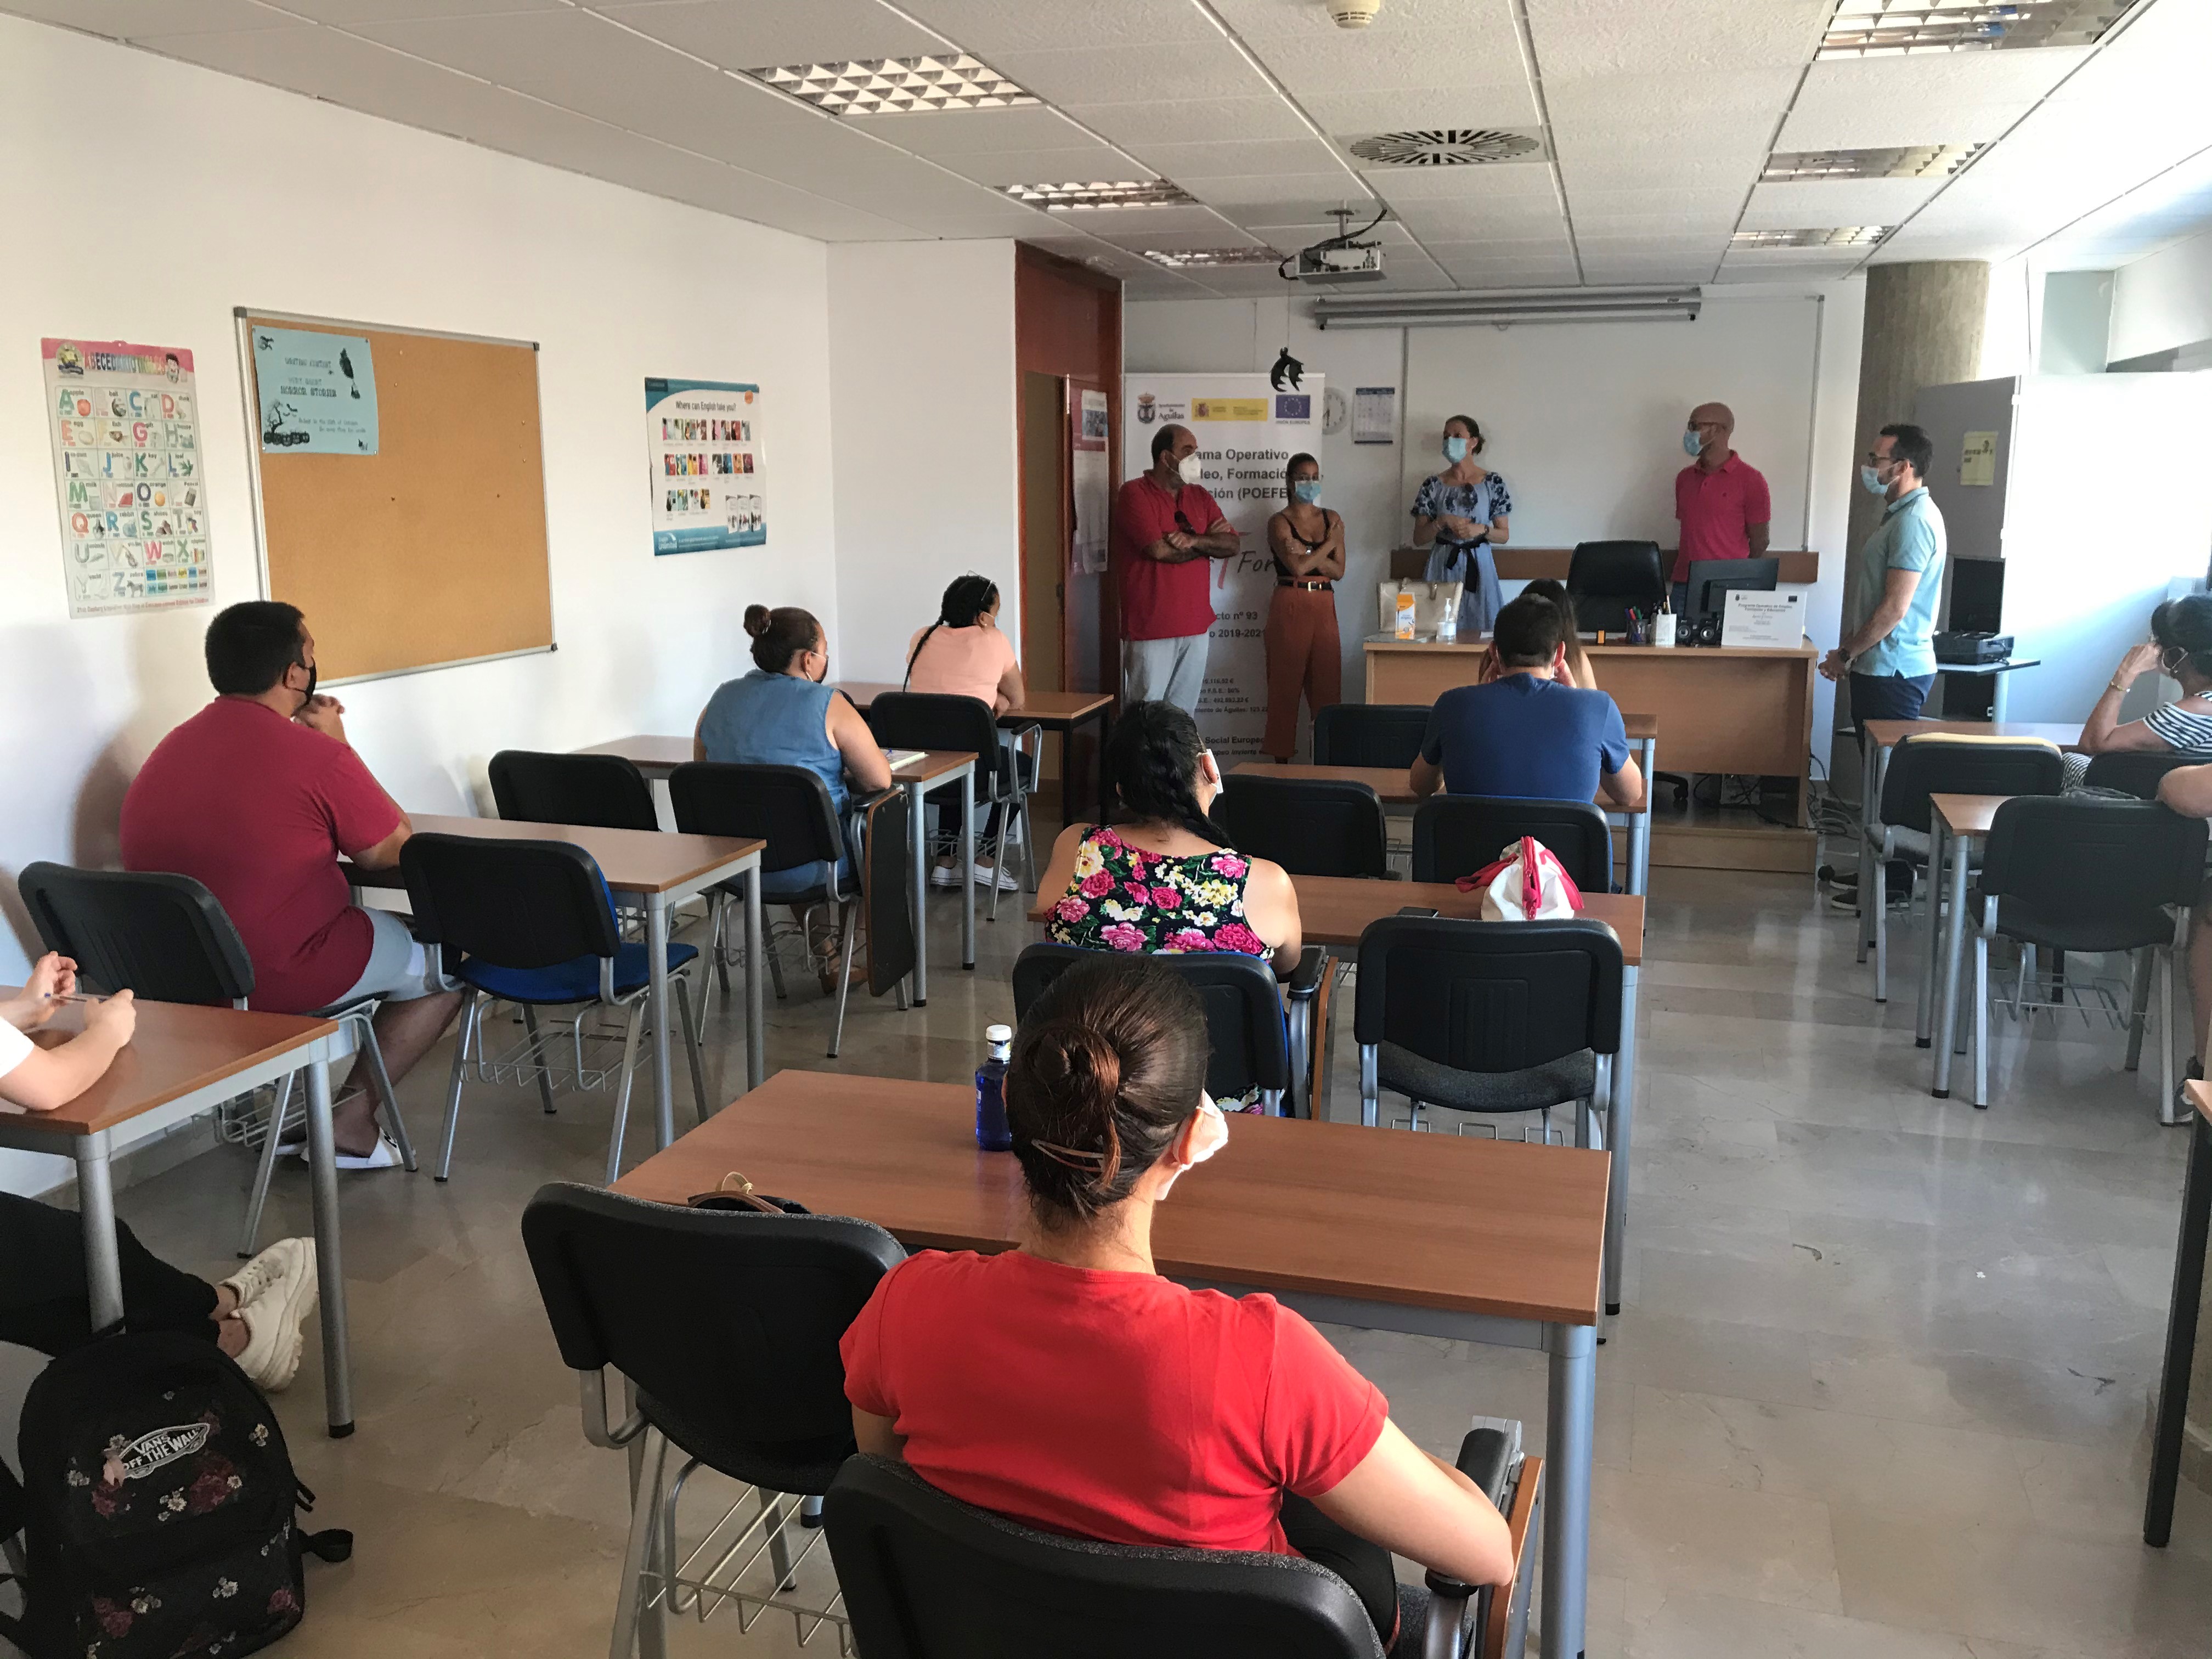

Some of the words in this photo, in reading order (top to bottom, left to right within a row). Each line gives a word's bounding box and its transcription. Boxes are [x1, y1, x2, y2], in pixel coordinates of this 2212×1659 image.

[59, 389, 75, 410] A
[129, 391, 142, 410] C
[161, 394, 174, 413] D
[676, 400, 691, 410] Where
[692, 402, 700, 410] can
[701, 402, 716, 412] English
[716, 402, 726, 410] take
[726, 403, 736, 412] you?
[61, 420, 73, 441] E
[133, 422, 148, 442] G
[165, 423, 178, 442] H
[135, 452, 148, 472] K
[168, 452, 177, 472] L
[1197, 451, 1222, 460] ama
[1226, 449, 1289, 462] Operativo
[1200, 468, 1223, 481] leo,
[1227, 468, 1287, 479] Formació
[69, 482, 88, 503] M
[137, 482, 151, 501] O
[1238, 487, 1289, 500] (POEFE
[72, 512, 89, 534] Q
[106, 511, 119, 532] R
[141, 511, 152, 531] S
[172, 509, 183, 529] T
[75, 543, 89, 563] U
[144, 540, 162, 560] W
[177, 539, 189, 558] X
[1237, 550, 1274, 573] For
[112, 572, 126, 591] Z
[1216, 612, 1231, 620] cto
[1246, 611, 1257, 619] 93
[134, 1436, 170, 1454] VANS
[143, 1443, 172, 1462] THE
[166, 1427, 200, 1452] WALL
